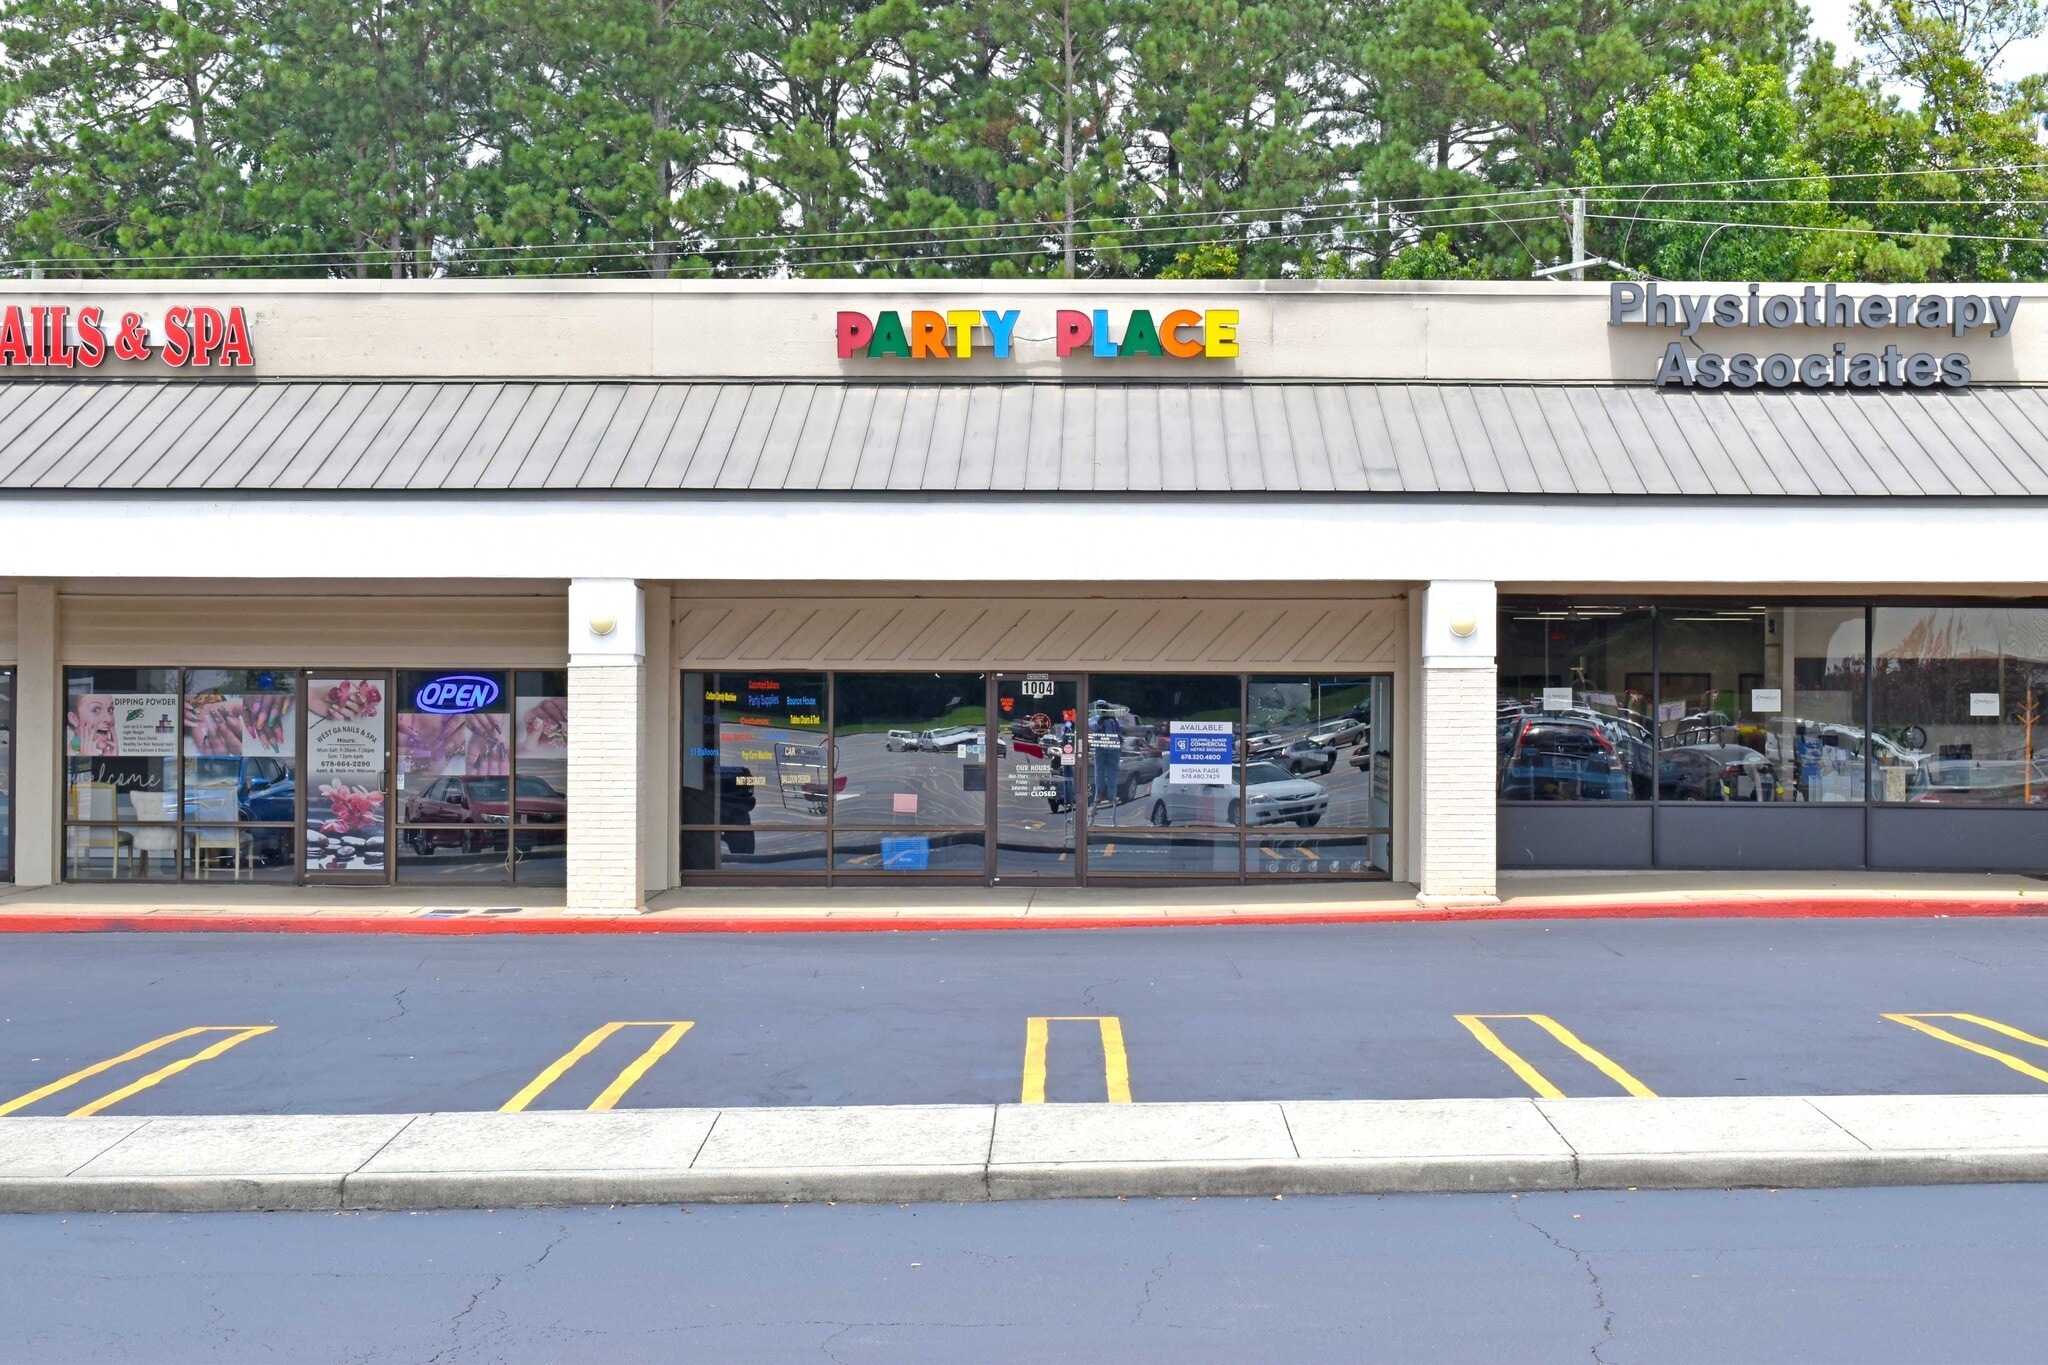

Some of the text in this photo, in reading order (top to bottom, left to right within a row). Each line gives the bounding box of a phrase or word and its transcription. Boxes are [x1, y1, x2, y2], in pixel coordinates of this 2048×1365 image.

[1610, 282, 2021, 337] Physiotherapy
[0, 305, 254, 367] AILS & SPA
[836, 309, 1240, 359] PARTY PLACE
[1656, 341, 1972, 388] Associates
[1024, 682, 1053, 694] 1004
[422, 683, 490, 707] OPEN
[748, 694, 779, 708] Party Supplies
[786, 696, 816, 706] Bounce House
[114, 698, 176, 706] DIPPING POWDER
[316, 729, 332, 743] WEST
[365, 732, 377, 743] SPA
[697, 748, 720, 756] Balloons
[784, 747, 796, 756] CAR
[1030, 764, 1051, 772] HOURS
[781, 774, 812, 785] BALLOON DESIGN
